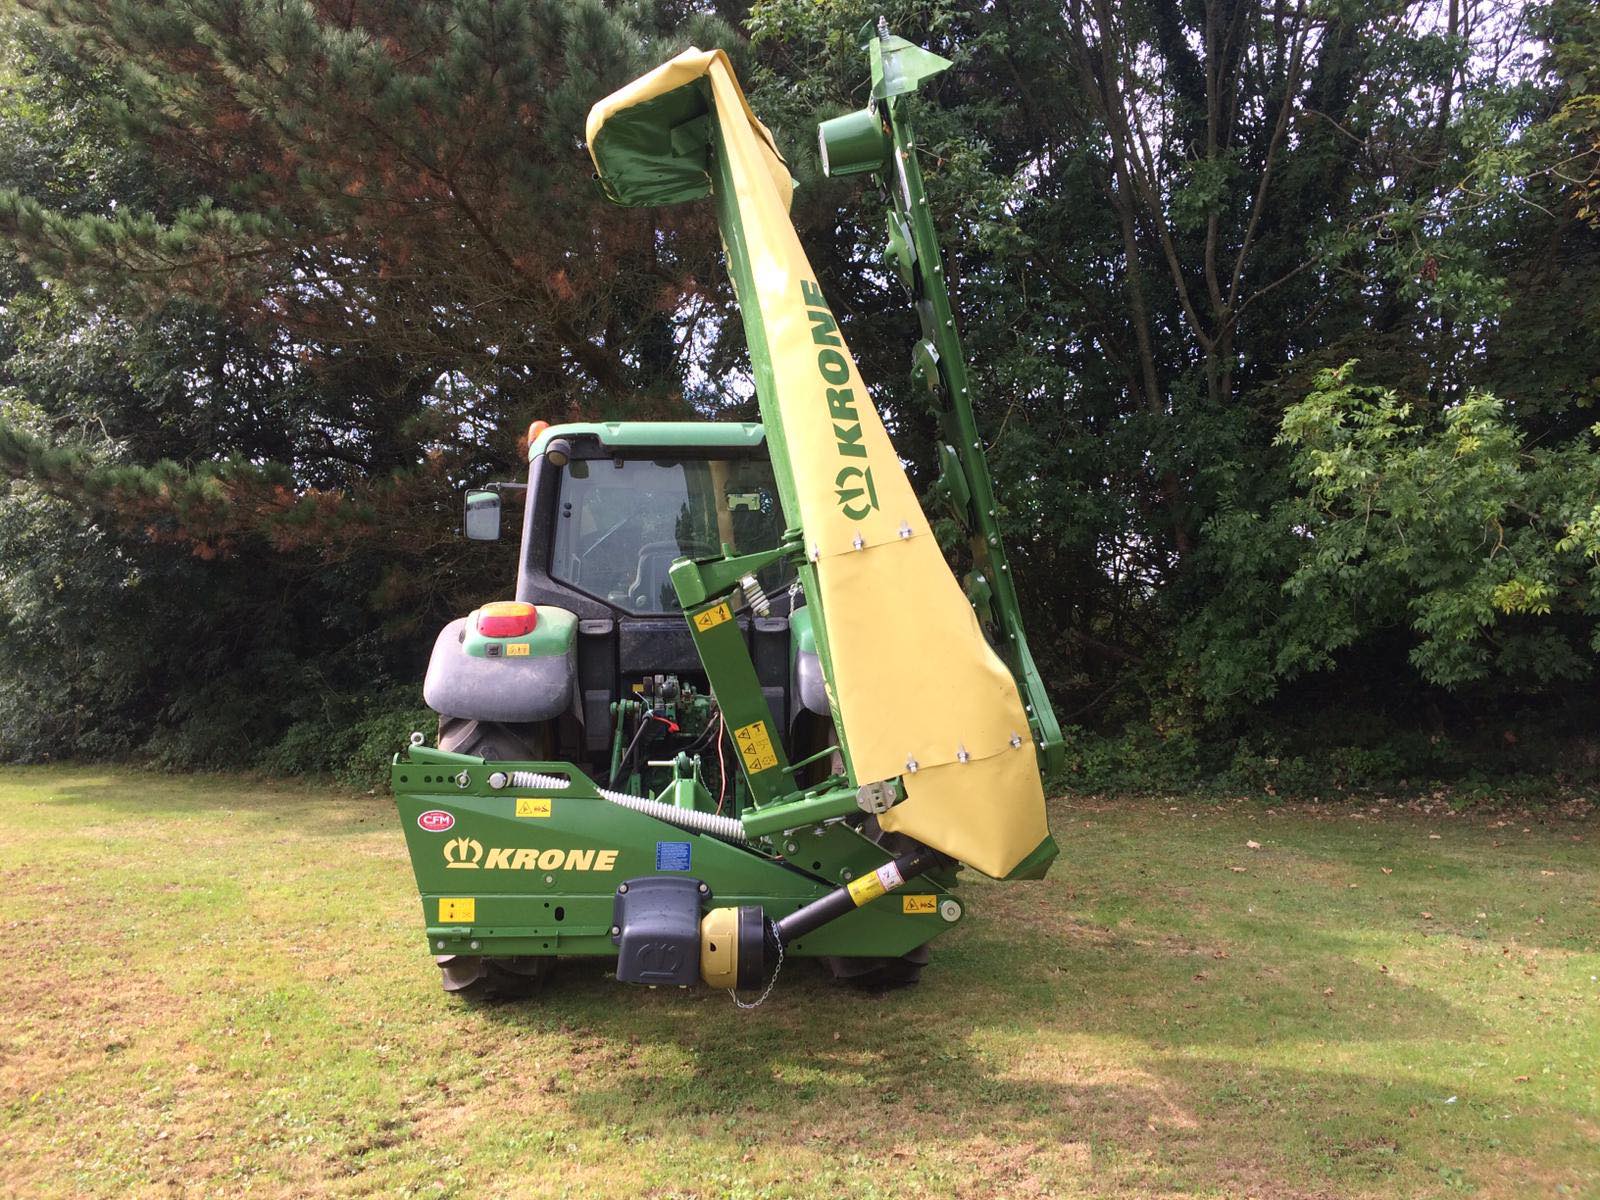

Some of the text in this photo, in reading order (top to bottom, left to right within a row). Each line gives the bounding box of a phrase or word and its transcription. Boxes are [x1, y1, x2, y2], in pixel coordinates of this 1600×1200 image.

[800, 279, 868, 458] KRONE
[423, 815, 450, 825] CFM
[484, 848, 619, 871] KRONE
